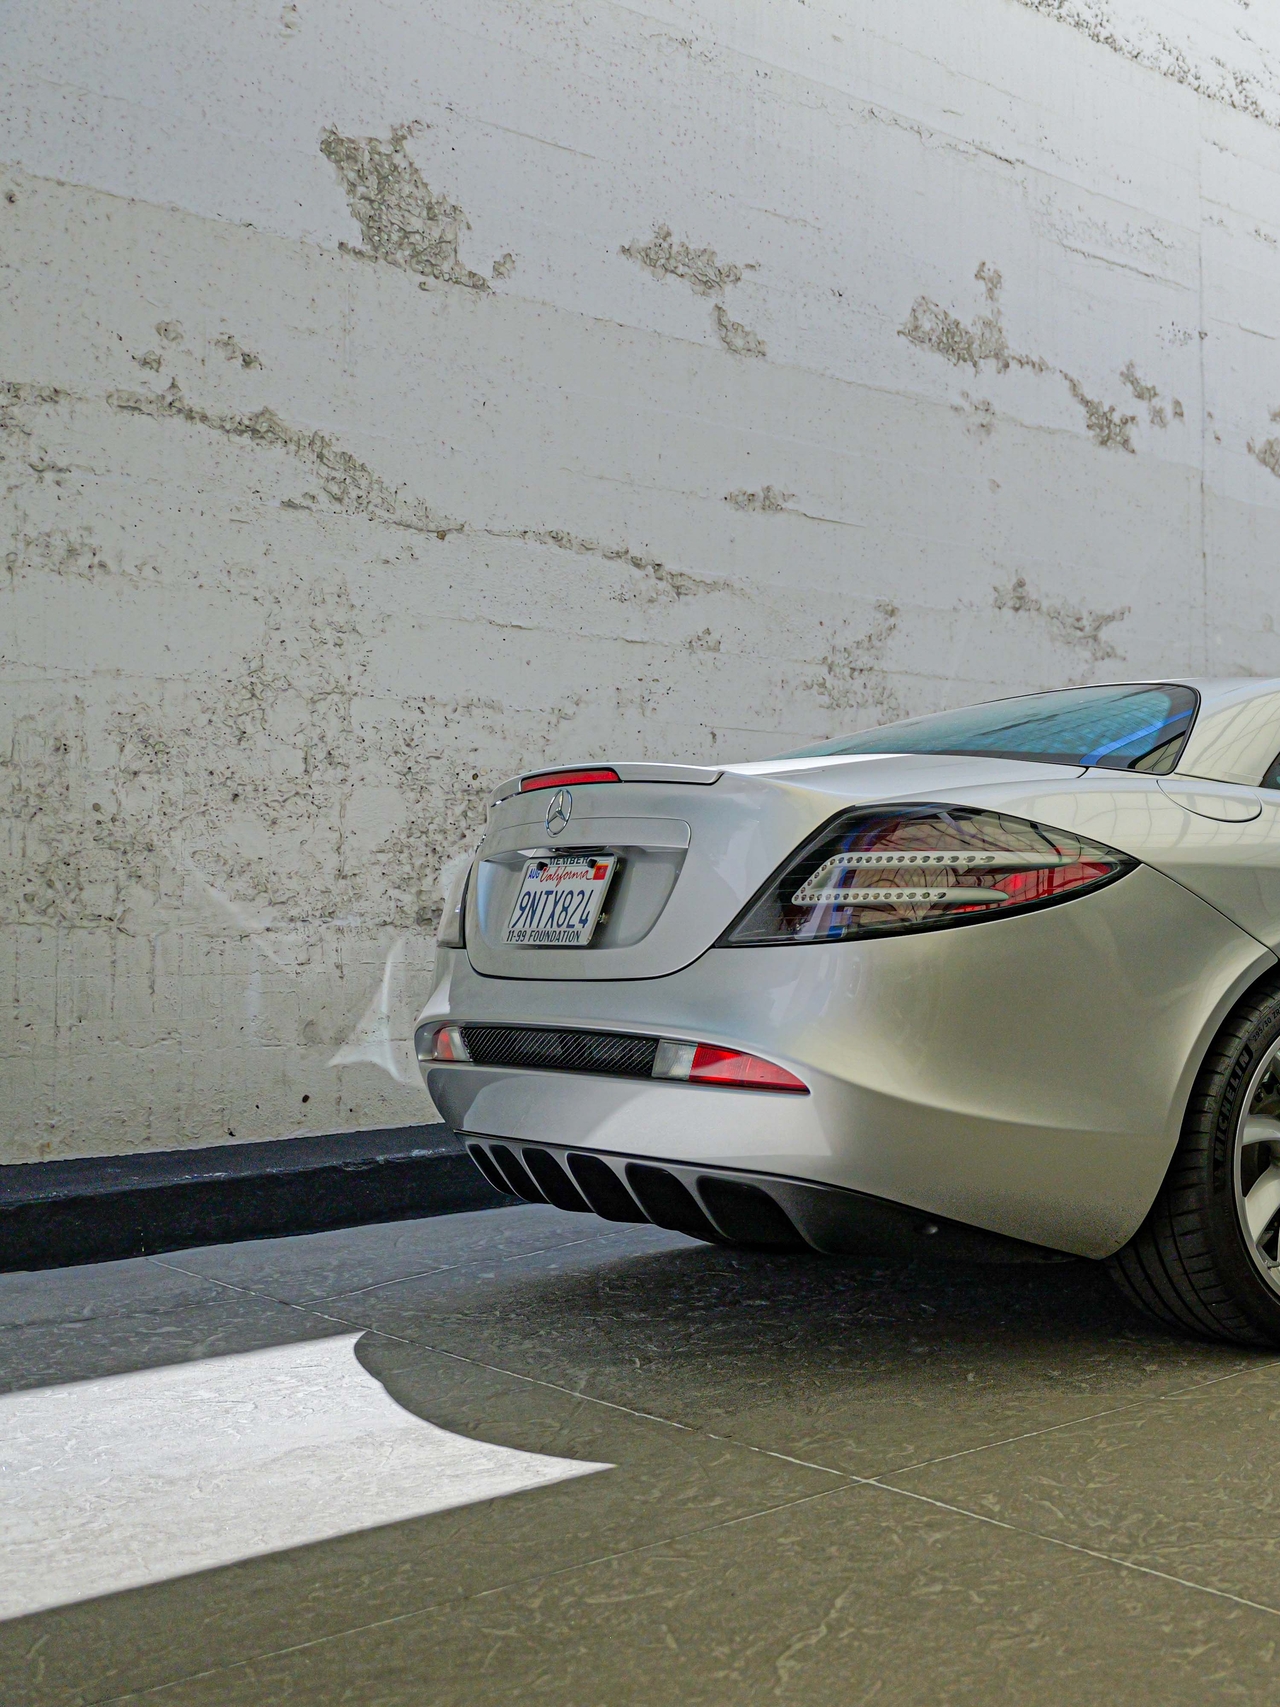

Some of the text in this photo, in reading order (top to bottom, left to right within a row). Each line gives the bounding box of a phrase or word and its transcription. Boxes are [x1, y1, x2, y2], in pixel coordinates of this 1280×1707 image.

[549, 857, 588, 865] MEMBER
[540, 866, 593, 888] California
[511, 890, 594, 929] 9NTX824
[506, 930, 581, 943] 11-99 FOUNDATION
[1252, 1016, 1272, 1042] 295/30
[1214, 1049, 1251, 1163] MICHELIN
